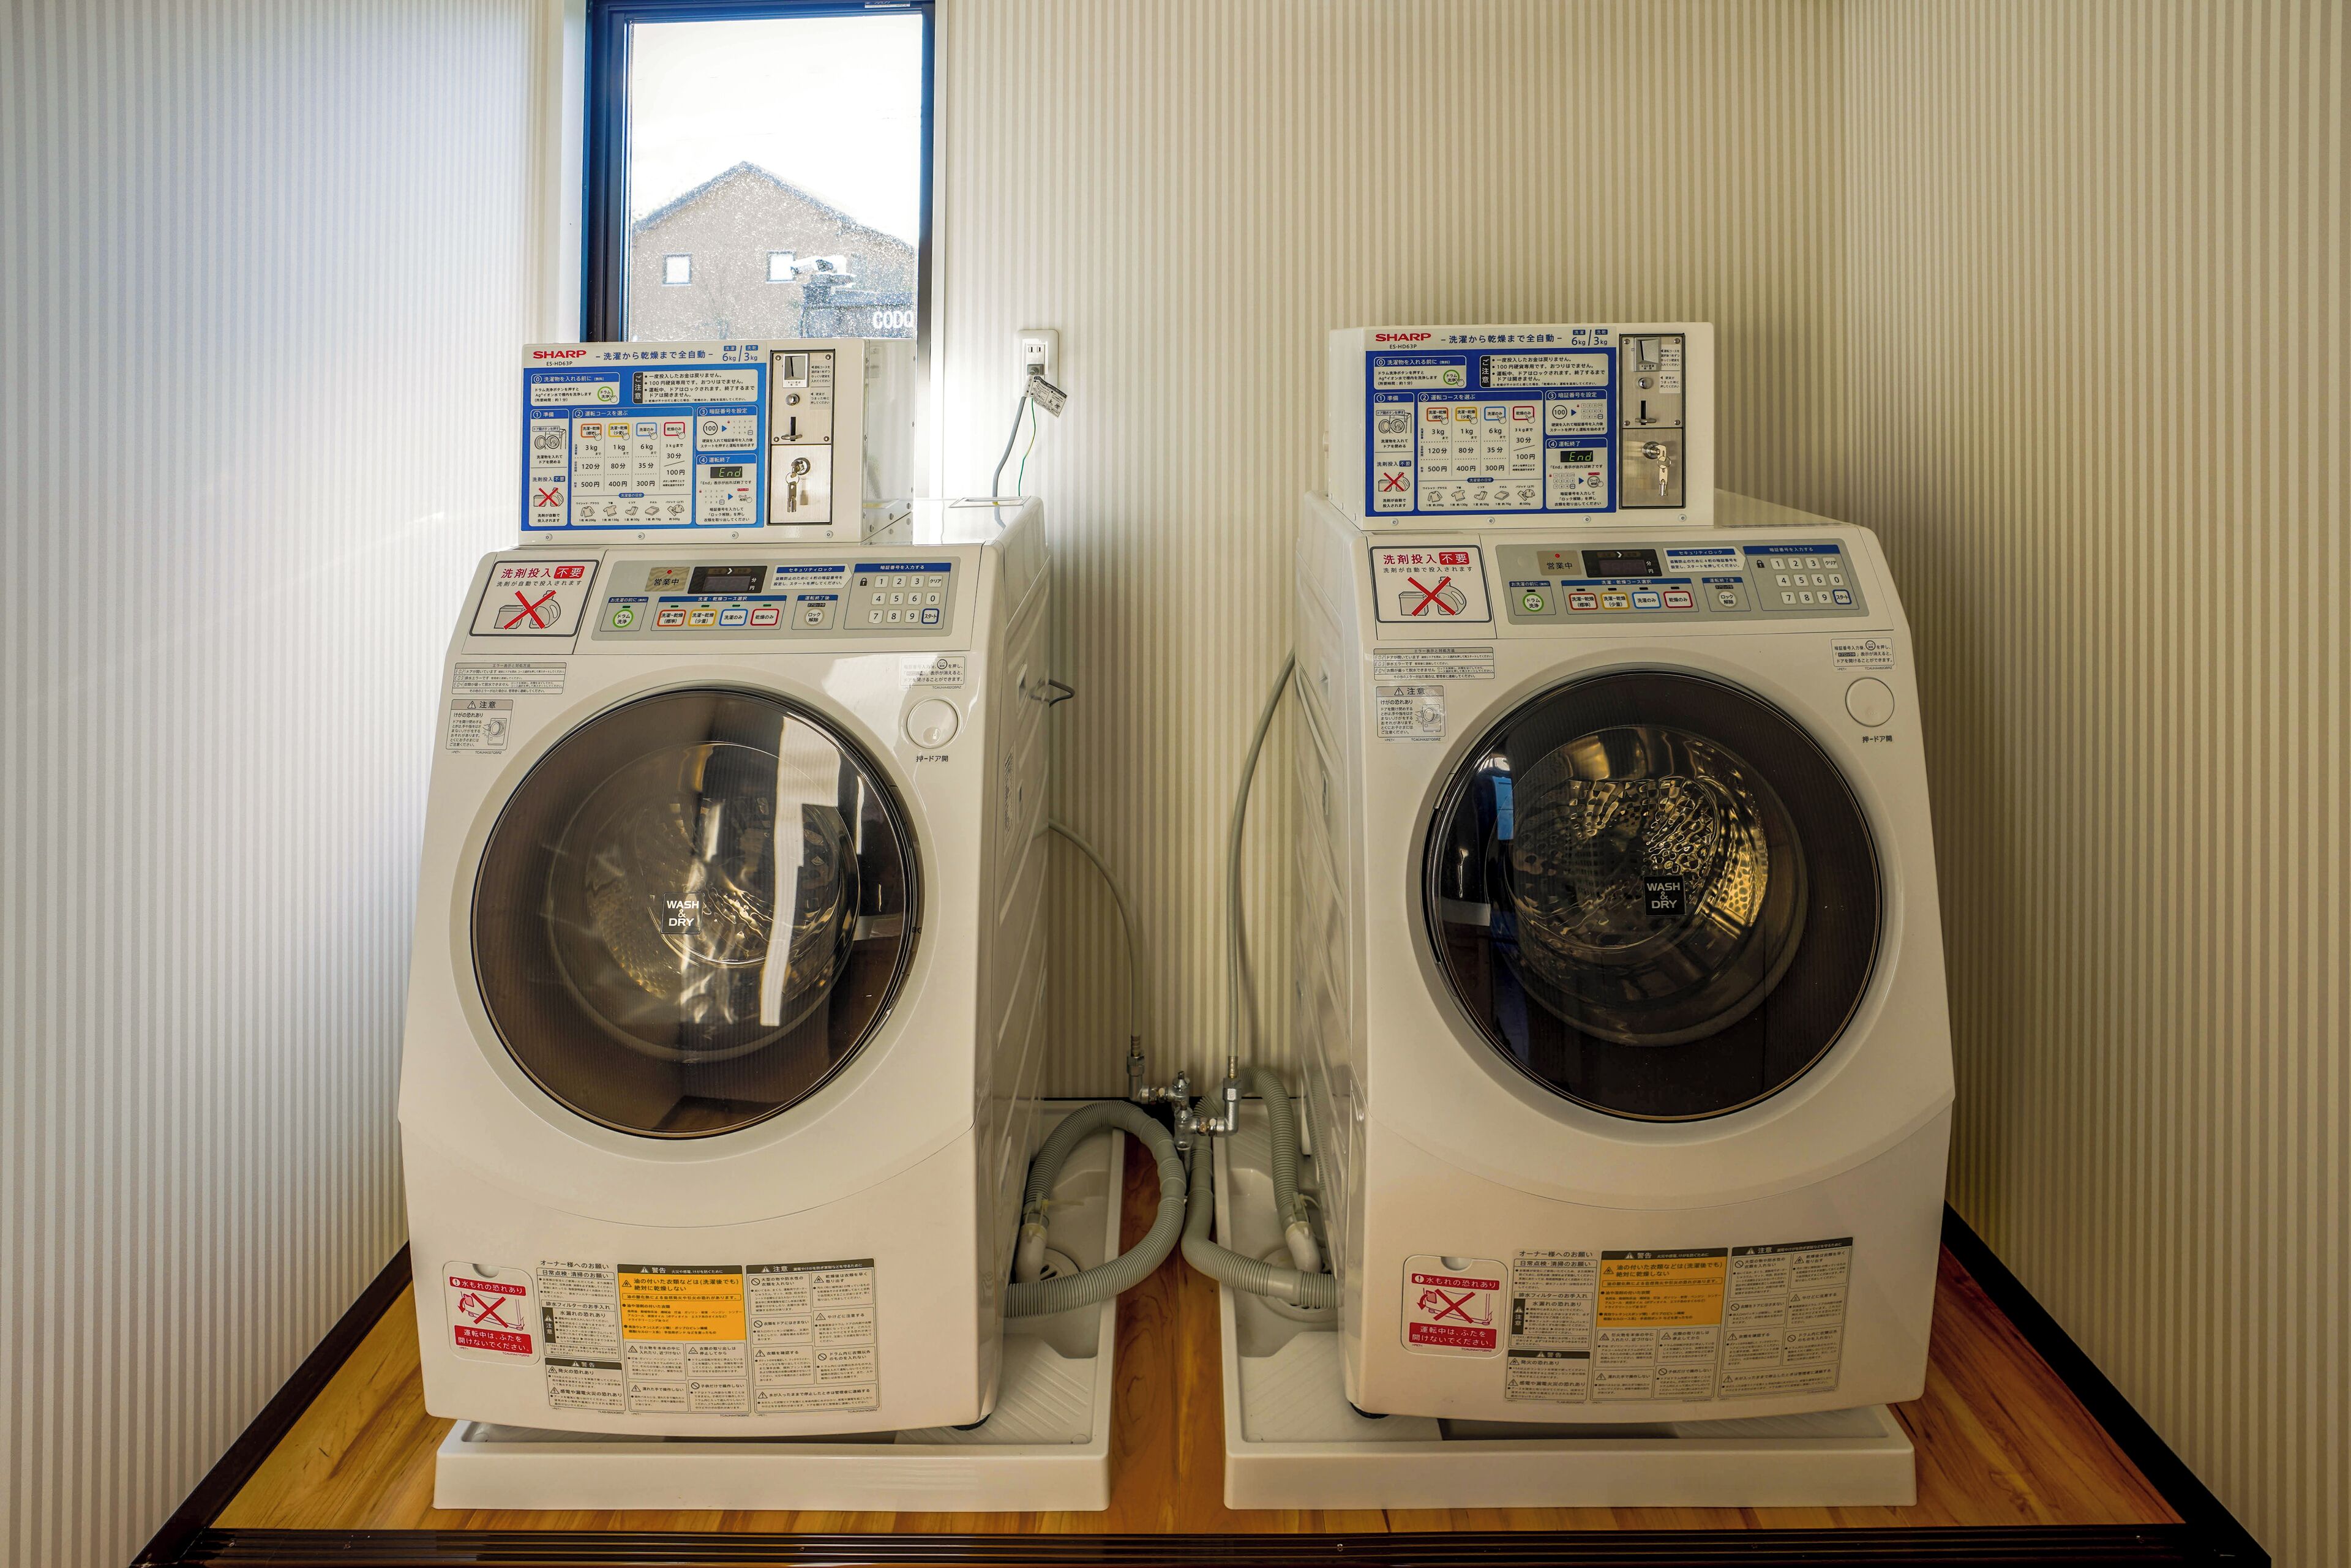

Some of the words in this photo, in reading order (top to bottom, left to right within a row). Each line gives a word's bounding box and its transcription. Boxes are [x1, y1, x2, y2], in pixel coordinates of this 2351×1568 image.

[1375, 332, 1431, 342] SHARP
[533, 350, 587, 359] SHARP
[1569, 451, 1592, 461] End
[719, 467, 741, 477] End
[1383, 553, 1437, 565] 洗剤投入
[1441, 553, 1467, 563] 不要
[1547, 561, 1573, 570] 営業中
[501, 568, 551, 579] 洗剤投入
[557, 568, 583, 577] 不要
[1646, 882, 1681, 891] WASH
[1660, 891, 1668, 900] &
[666, 900, 699, 909] WASH
[1651, 900, 1678, 909] DRY
[678, 909, 686, 918] &
[669, 918, 694, 926] DRY
[541, 1260, 609, 1269] オーナー様へのお願い
[462, 1280, 522, 1294] 水もれの恐れあり
[1426, 1277, 1496, 1288] 水もれの恐れあり
[463, 1329, 522, 1342] 運転中は、ふたを
[1420, 1326, 1486, 1338] 運転中は、ふたを
[458, 1337, 530, 1351] 開けないでください。
[1412, 1334, 1493, 1346] 開けないでください。
